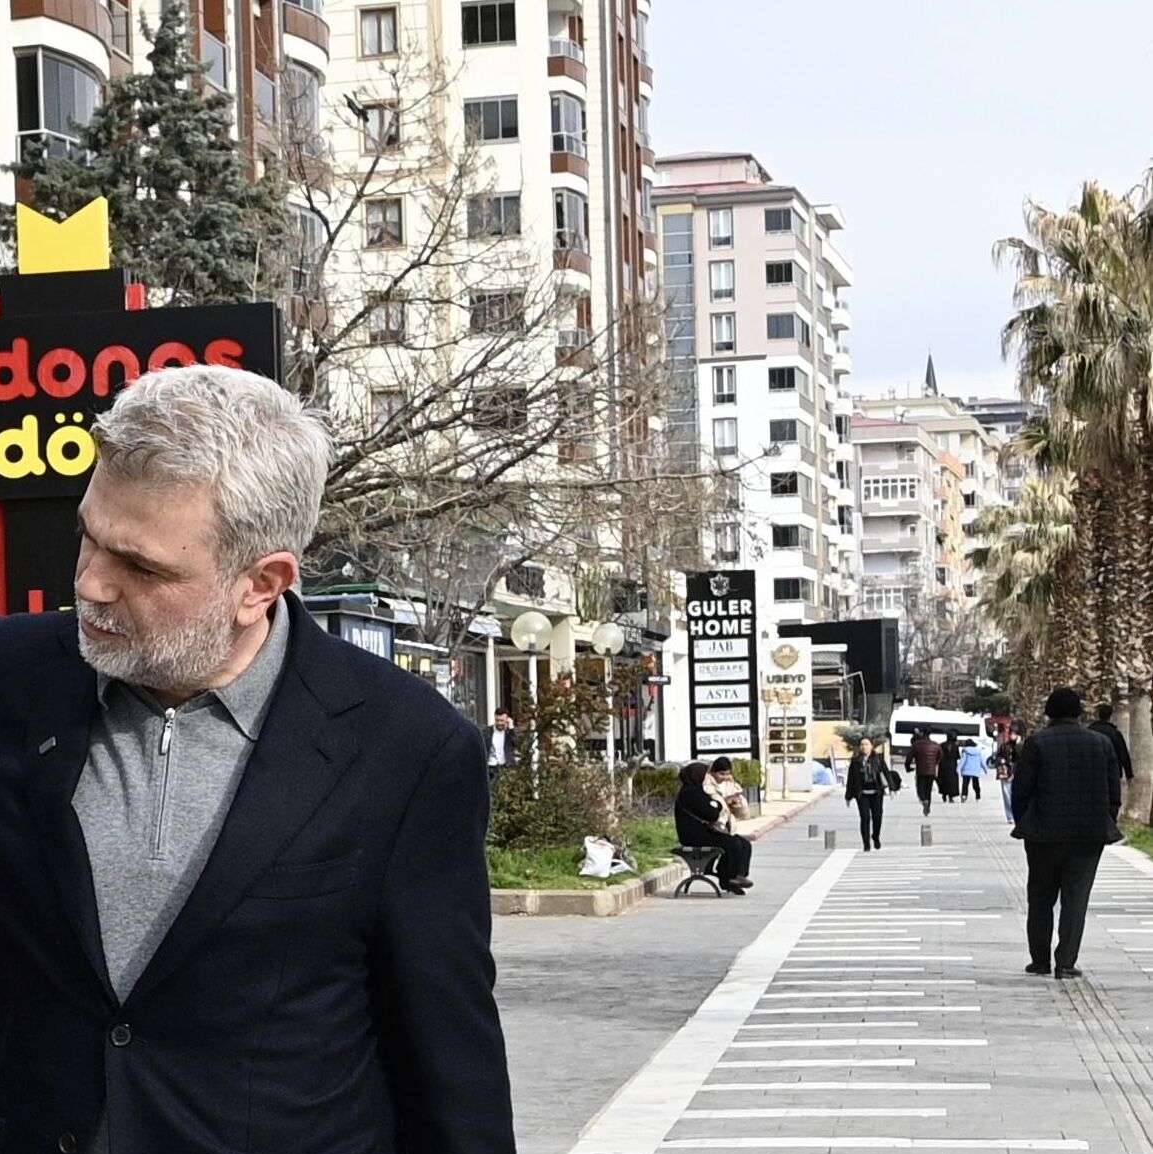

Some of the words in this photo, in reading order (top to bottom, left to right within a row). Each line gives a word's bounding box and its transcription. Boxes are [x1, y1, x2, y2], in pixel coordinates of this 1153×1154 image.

[687, 599, 753, 617] GULER
[690, 619, 753, 636] HOME
[709, 641, 734, 652] JAB
[766, 673, 806, 684] UBEYD
[706, 688, 739, 700] ASTA
